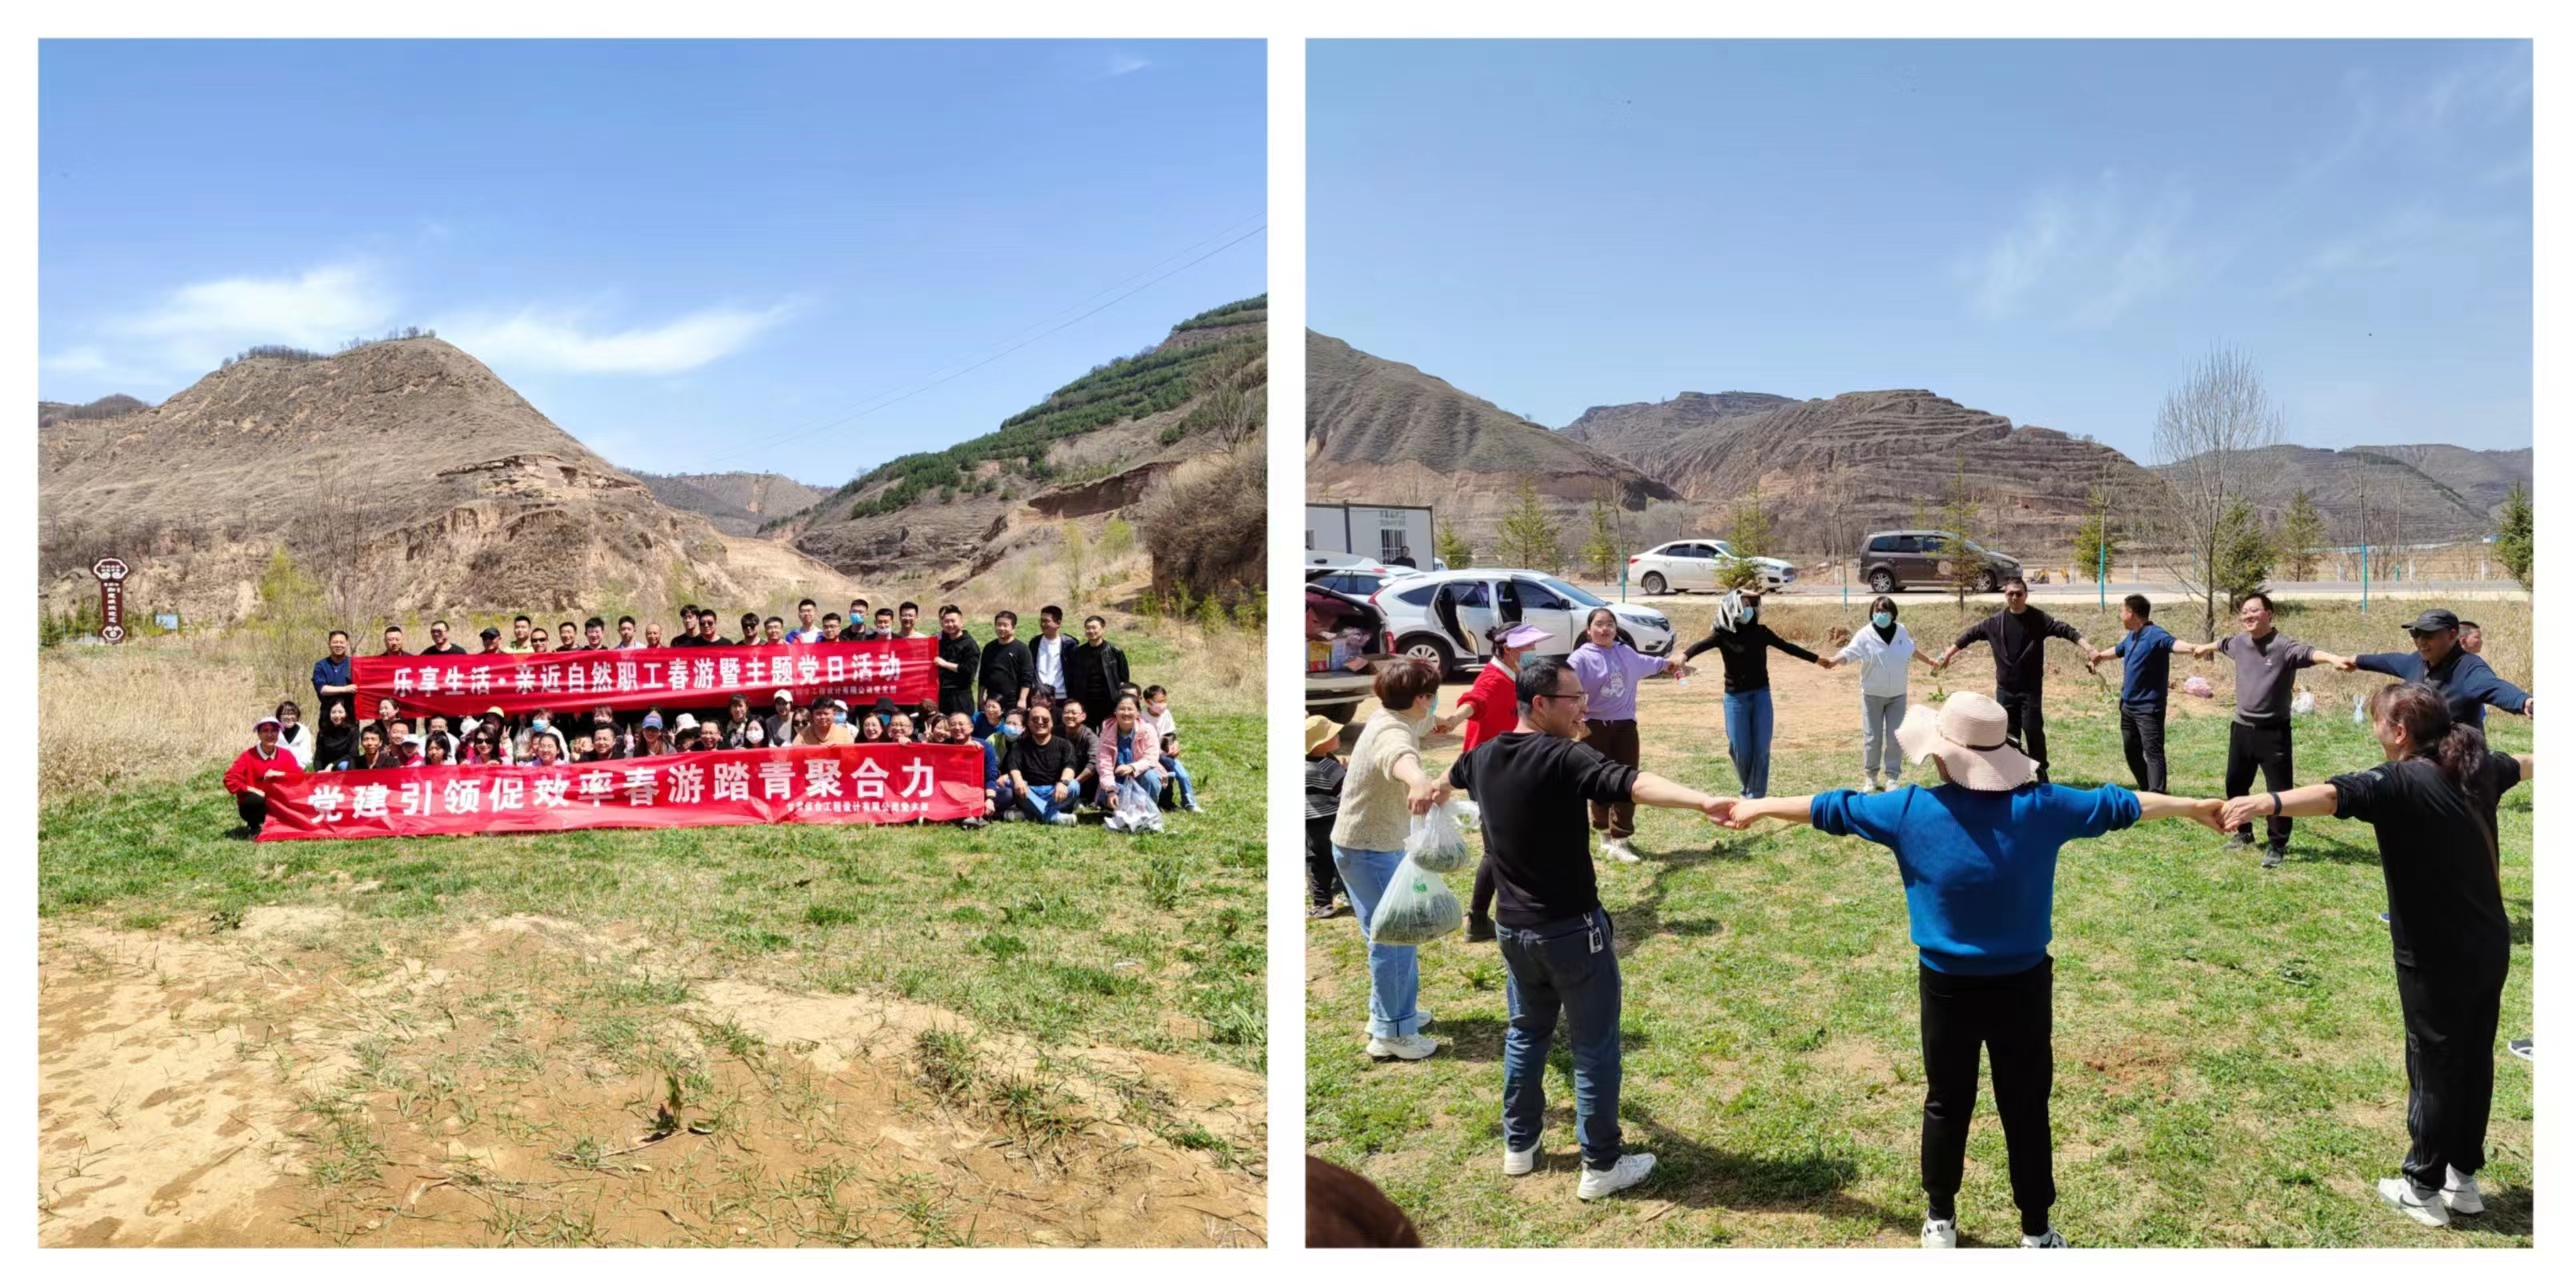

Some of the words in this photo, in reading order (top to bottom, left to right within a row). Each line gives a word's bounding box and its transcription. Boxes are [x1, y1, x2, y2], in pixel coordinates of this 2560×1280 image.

[308, 757, 935, 823] 党建引领促效率春游踏青聚合力
